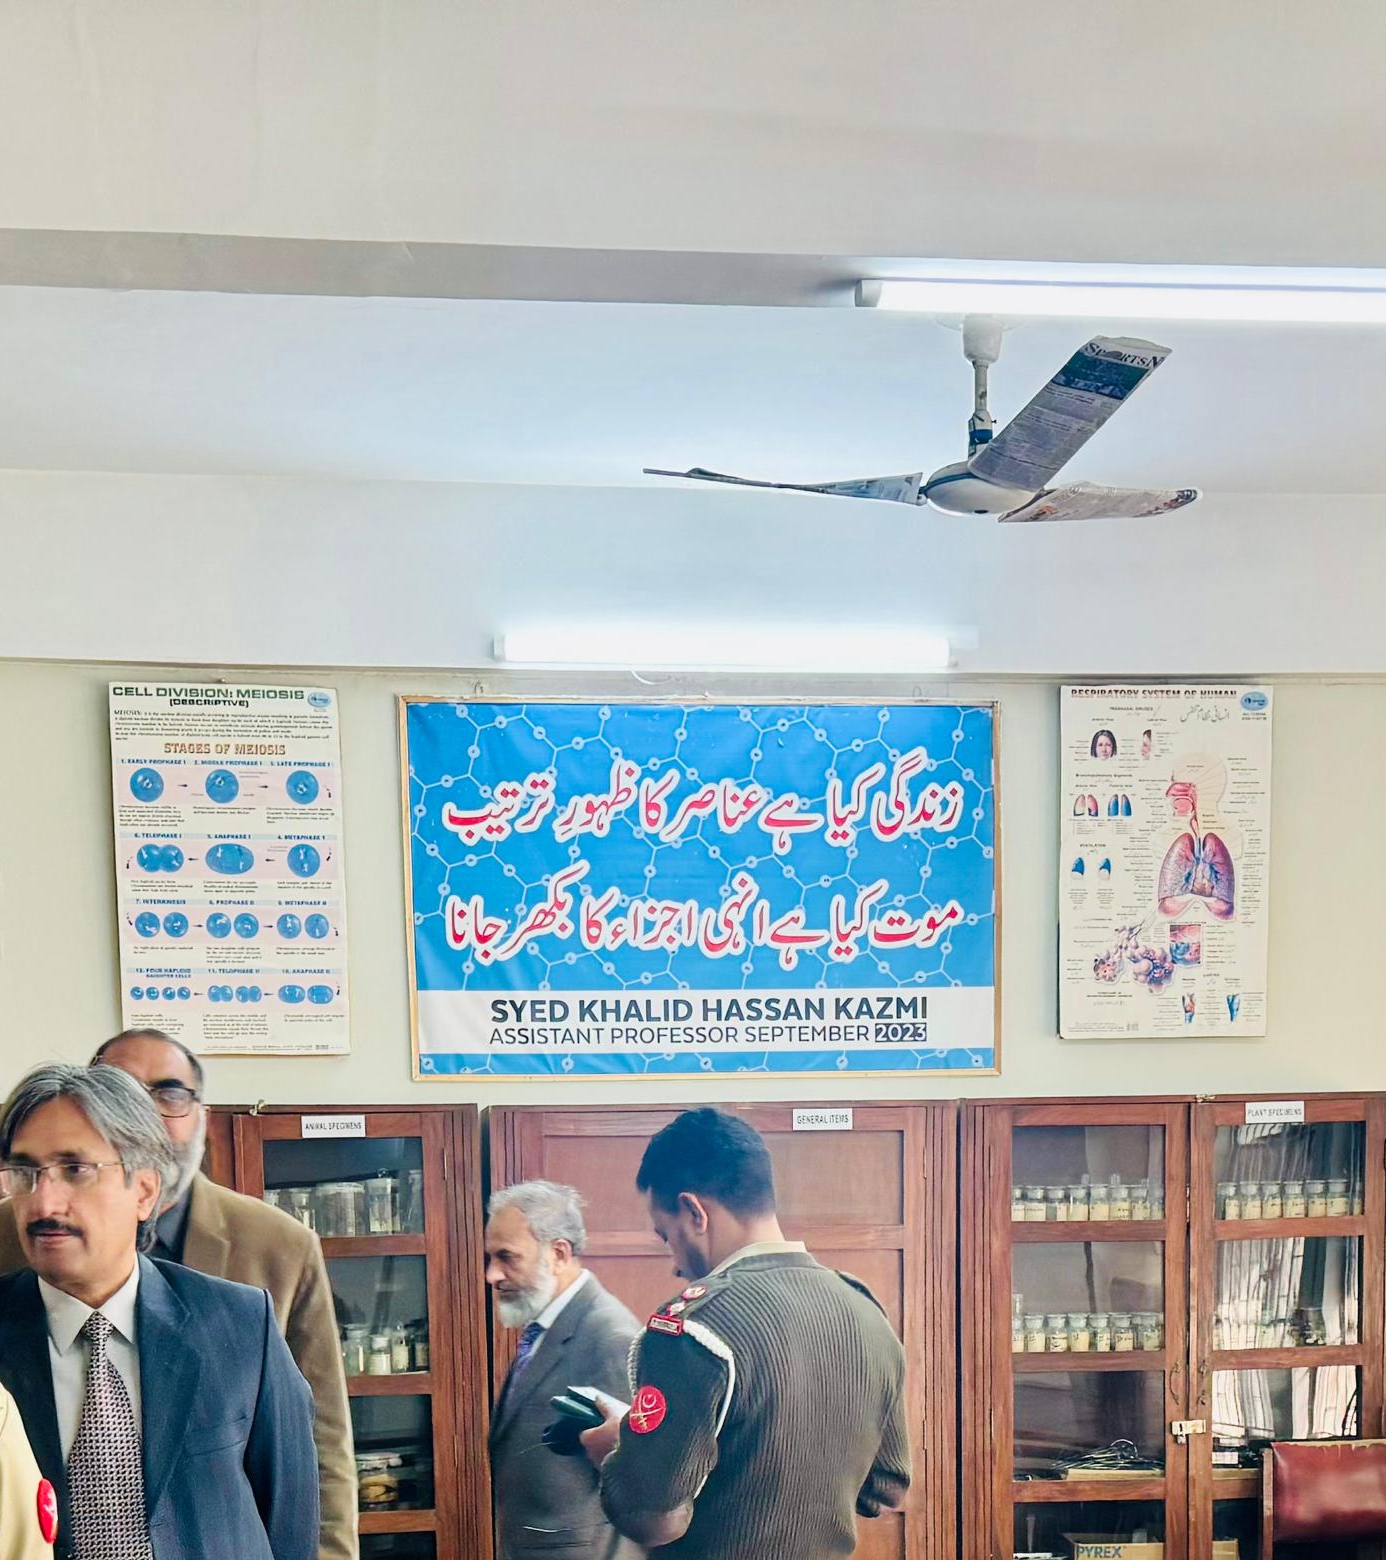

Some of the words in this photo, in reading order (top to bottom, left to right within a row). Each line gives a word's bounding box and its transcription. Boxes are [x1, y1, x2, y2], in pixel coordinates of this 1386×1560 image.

[113, 686, 153, 697] CELL
[156, 687, 234, 698] DIVISION:
[236, 690, 305, 700] MEIOSIS
[1071, 689, 1140, 699] RESPIRATORY
[1141, 689, 1181, 699] SYSTEM
[1184, 690, 1198, 699] OF
[1200, 690, 1237, 699] HUMAN
[164, 743, 211, 754] STAGES
[214, 743, 230, 754] OF
[234, 744, 286, 755] MEIOSIS
[446, 776, 552, 841] ترتیب
[642, 772, 677, 829] کا
[662, 782, 764, 839] عناصر
[830, 765, 882, 842] کیا
[875, 751, 961, 837] زندگی
[762, 796, 821, 850] ہے
[584, 890, 618, 945] کا
[768, 912, 827, 967] ہے
[832, 882, 885, 957] کیا
[871, 902, 961, 945] موت
[491, 998, 570, 1023] SYED
[578, 998, 694, 1022] KHALID
[702, 997, 825, 1022] HASSAN
[835, 996, 927, 1020] KAZMI
[489, 1027, 604, 1045] ASSISTANT
[611, 1026, 739, 1044] PROFESSOR
[745, 1025, 869, 1043] SEPTEMBER
[875, 1023, 927, 1042] 2023
[305, 1122, 327, 1130] ANIMAL
[328, 1121, 362, 1130] SPECIMENS
[797, 1114, 828, 1125] GENERAL
[829, 1114, 849, 1124] ITEMS
[1248, 1108, 1267, 1117] PLANT
